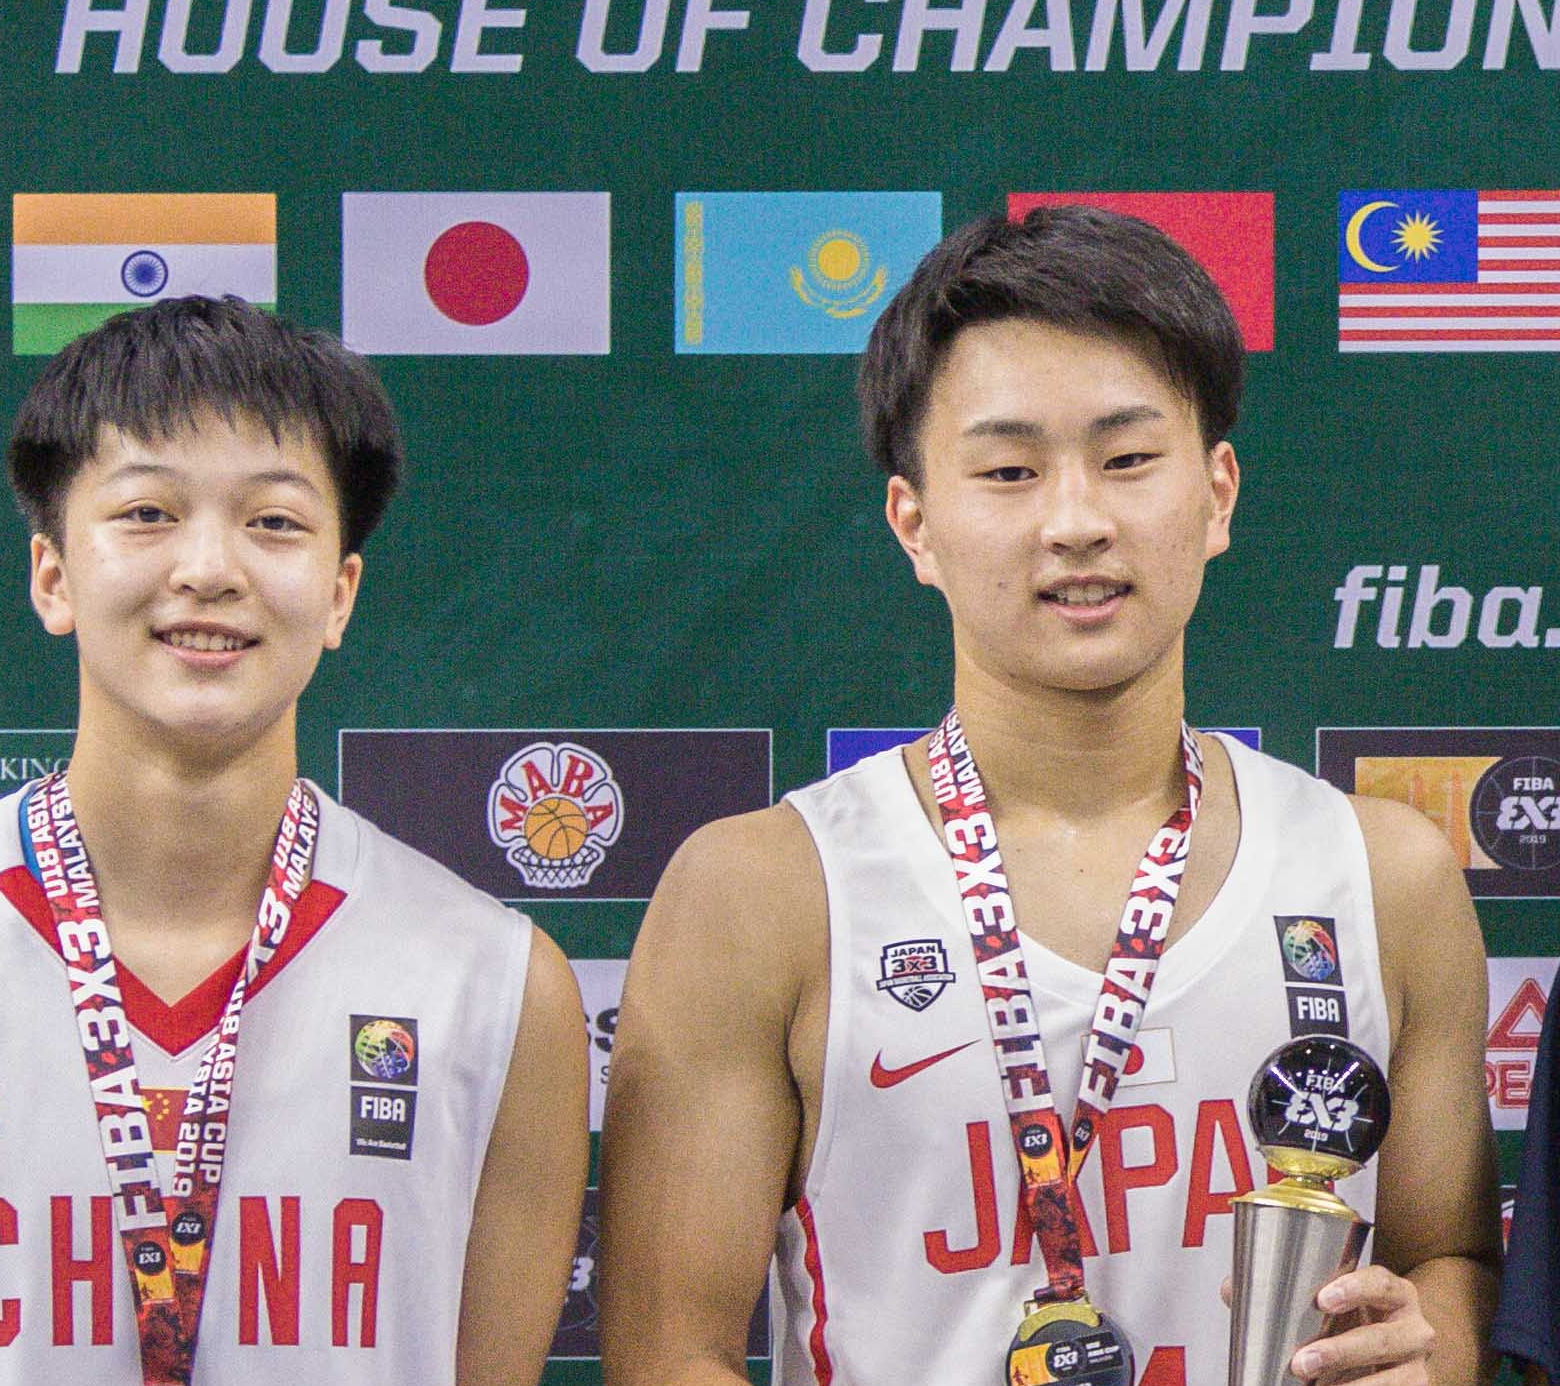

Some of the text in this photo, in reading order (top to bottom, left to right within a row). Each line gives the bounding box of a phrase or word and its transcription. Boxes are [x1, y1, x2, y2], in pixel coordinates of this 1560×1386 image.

[501, 757, 612, 836] MABA
[1513, 777, 1554, 791] FIBA
[1297, 996, 1339, 1021] FIBA
[361, 1096, 405, 1121] FIBA
